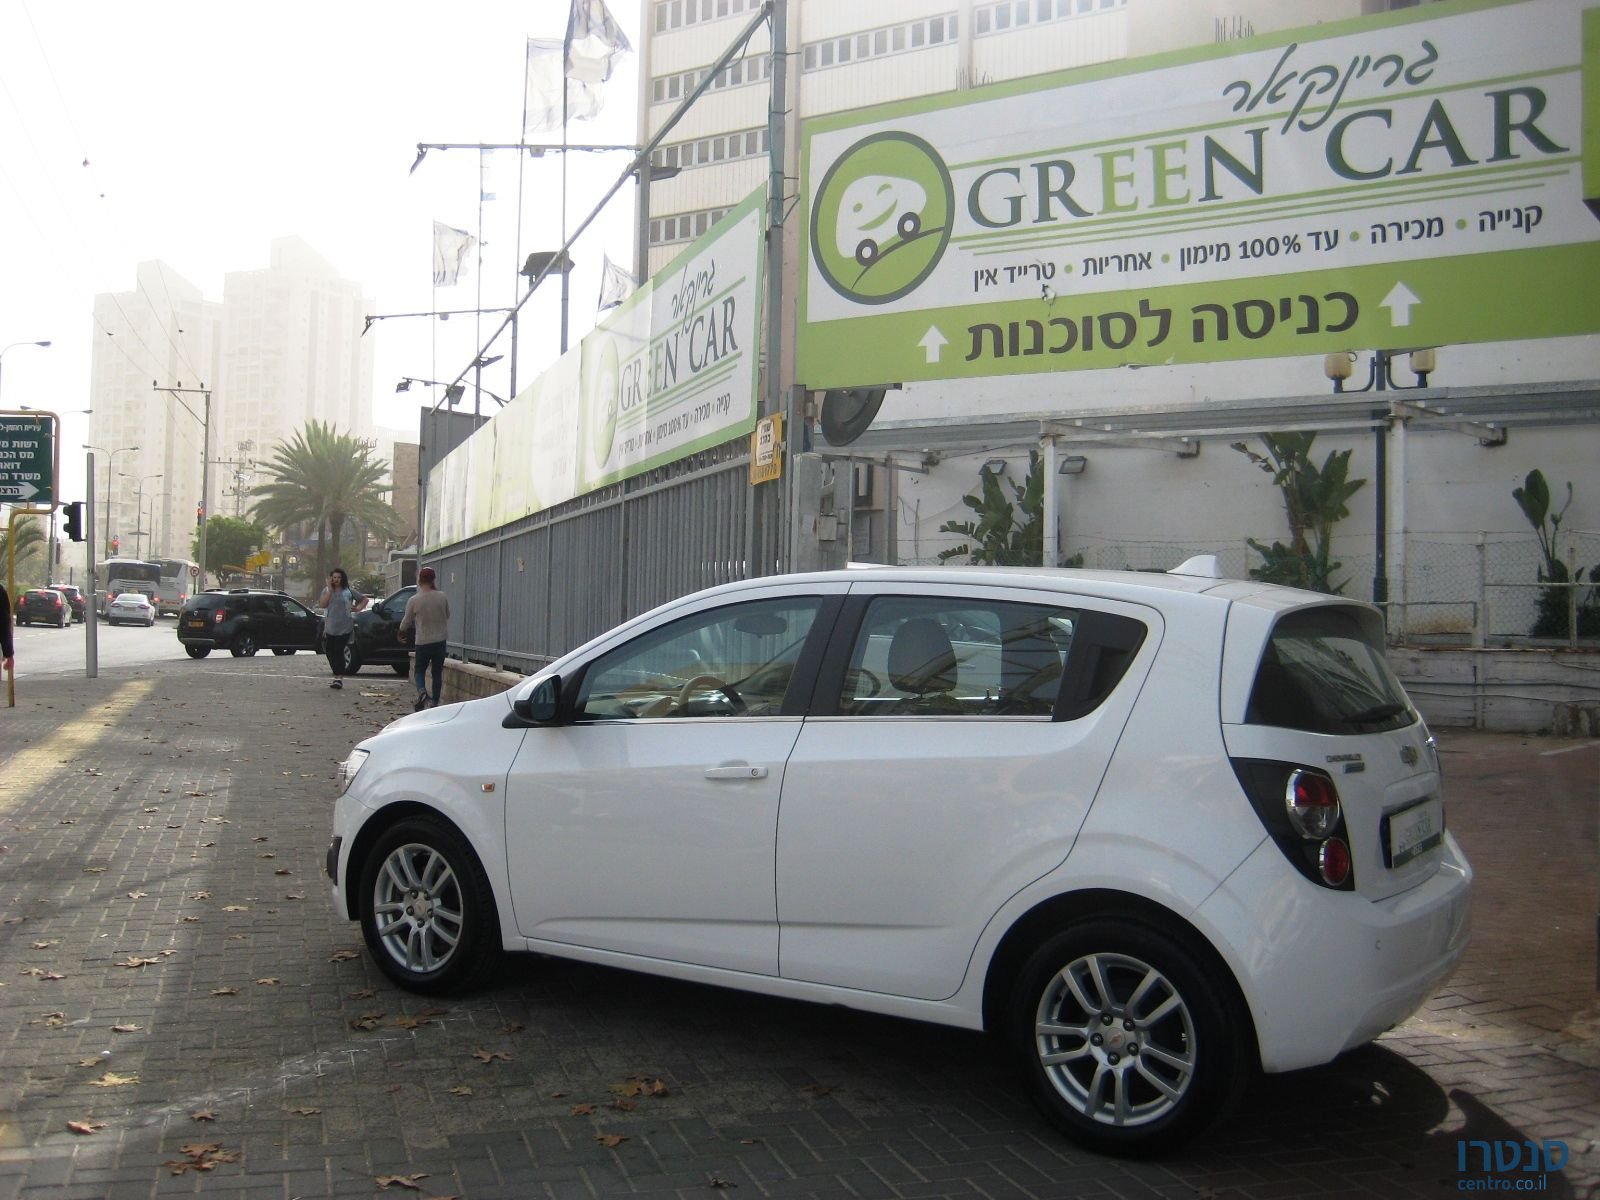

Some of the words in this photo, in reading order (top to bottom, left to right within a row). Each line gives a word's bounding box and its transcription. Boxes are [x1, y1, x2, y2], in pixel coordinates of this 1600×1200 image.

[967, 127, 1269, 228] GREEN
[1325, 86, 1570, 181] CAR
[1370, 216, 1444, 245] מכירה
[1478, 204, 1543, 233] קנייה
[1238, 234, 1302, 260] 100%
[1306, 229, 1339, 252] עד
[1082, 251, 1153, 277] אחריות
[1179, 242, 1231, 271] מימון
[973, 267, 998, 292] אין
[1003, 261, 1057, 284] טרייד
[965, 298, 1172, 362] לסוכנות
[1191, 291, 1360, 343] כניסה
[689, 295, 738, 374] CAR
[11, 440, 39, 449] רשות
[19, 451, 35, 459] מס
[11, 472, 41, 481] משרד
